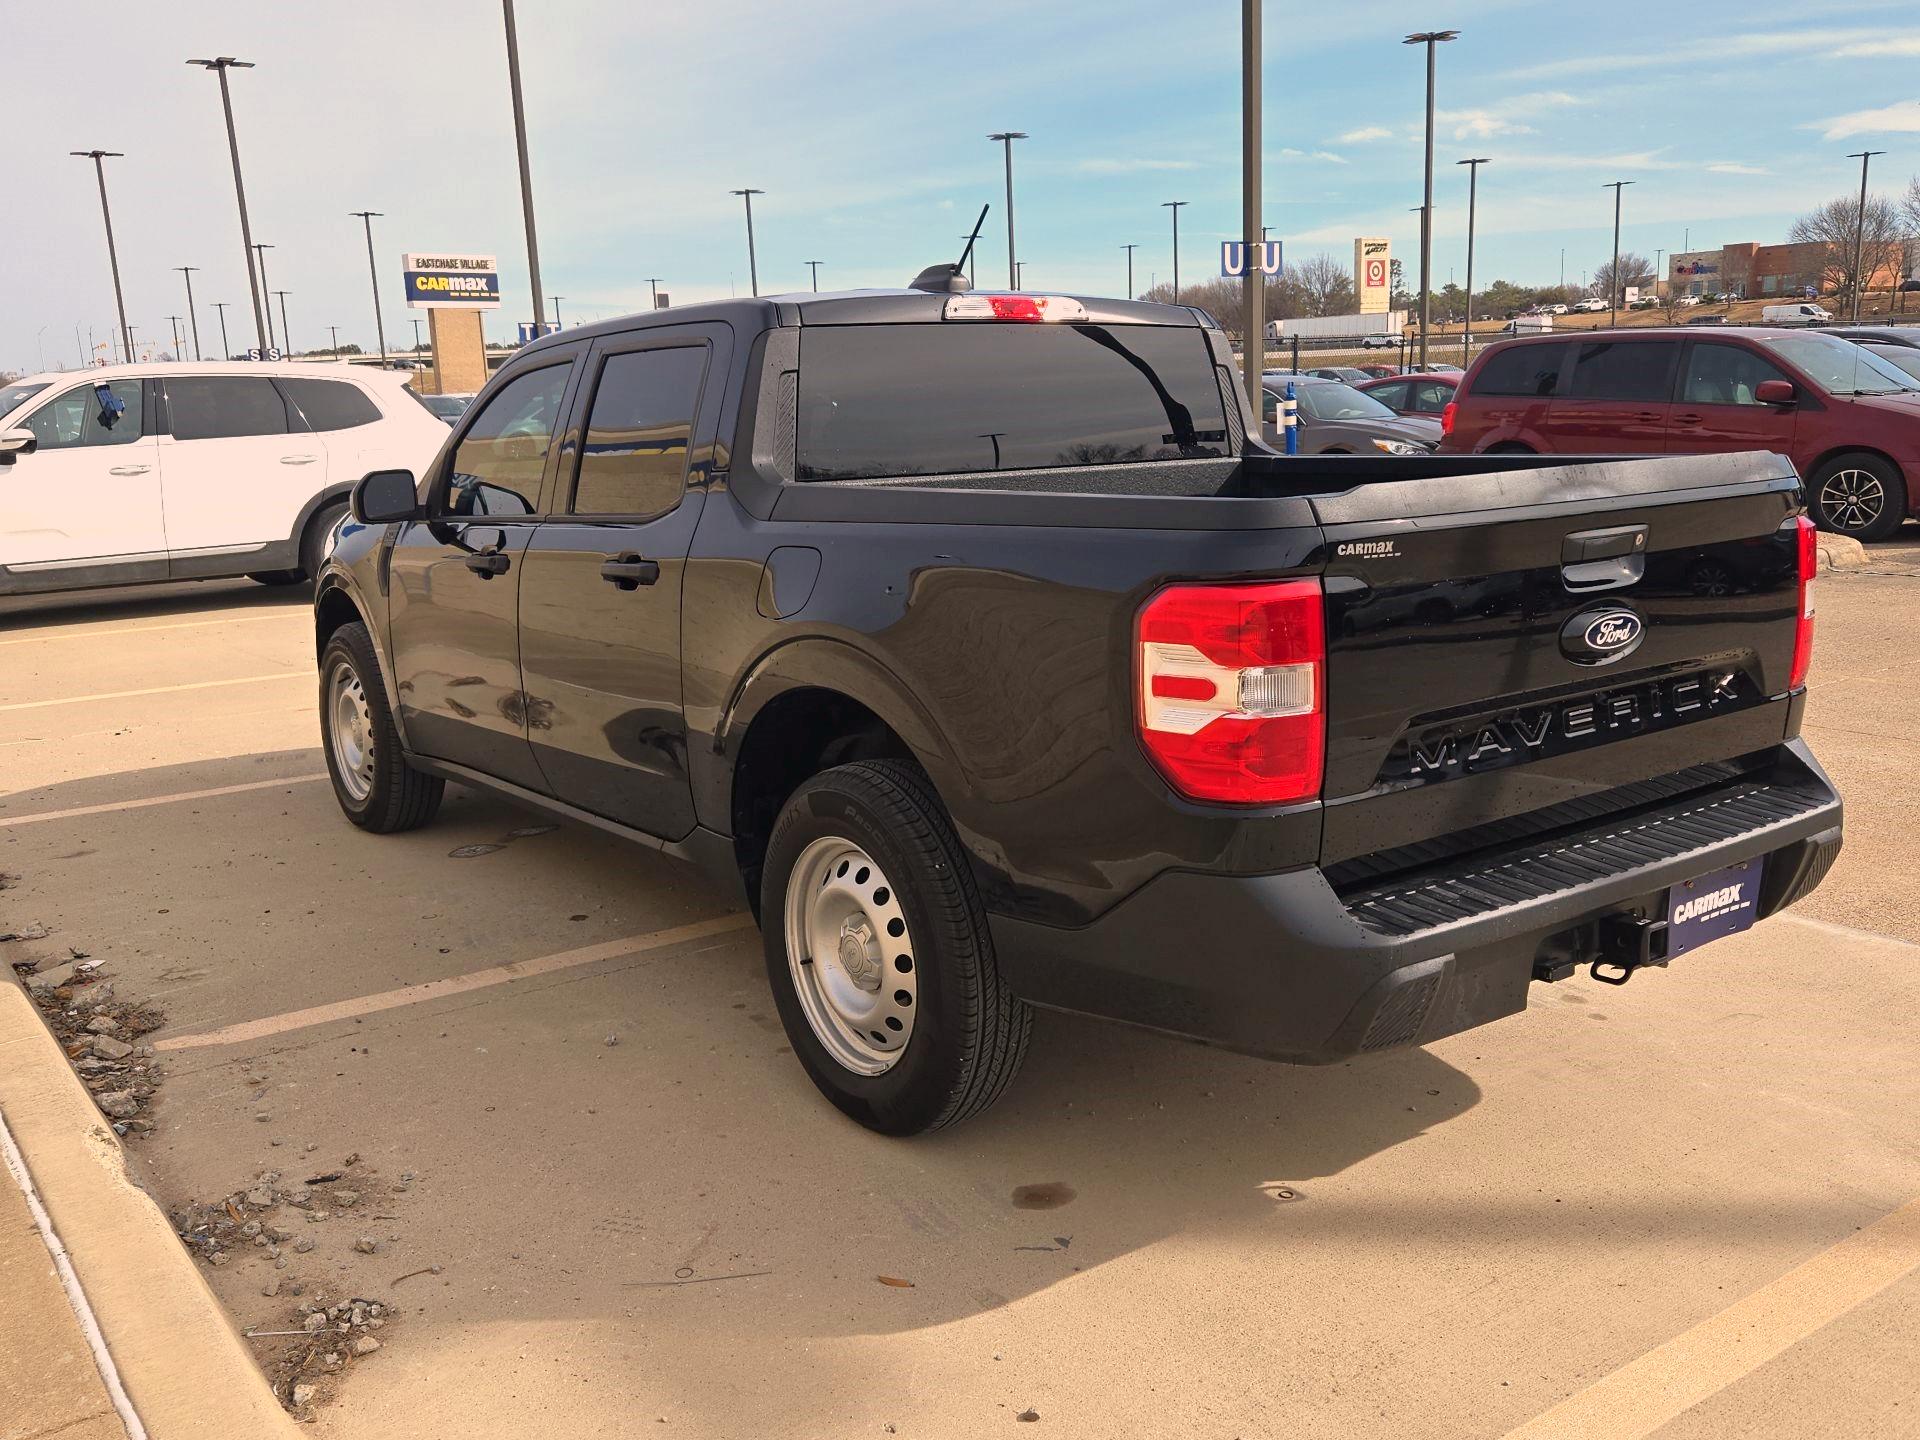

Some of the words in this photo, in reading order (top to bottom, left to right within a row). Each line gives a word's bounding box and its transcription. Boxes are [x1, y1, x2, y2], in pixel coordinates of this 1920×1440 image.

[416, 258, 459, 269] EASTCHASE
[459, 259, 490, 270] VILLAGE
[1225, 243, 1243, 275] U
[1262, 243, 1280, 274] U
[521, 323, 533, 341] T
[251, 349, 260, 361] S
[269, 349, 279, 361] S
[1596, 618, 1632, 645] Ford
[1408, 674, 1738, 773] MAVERICK
